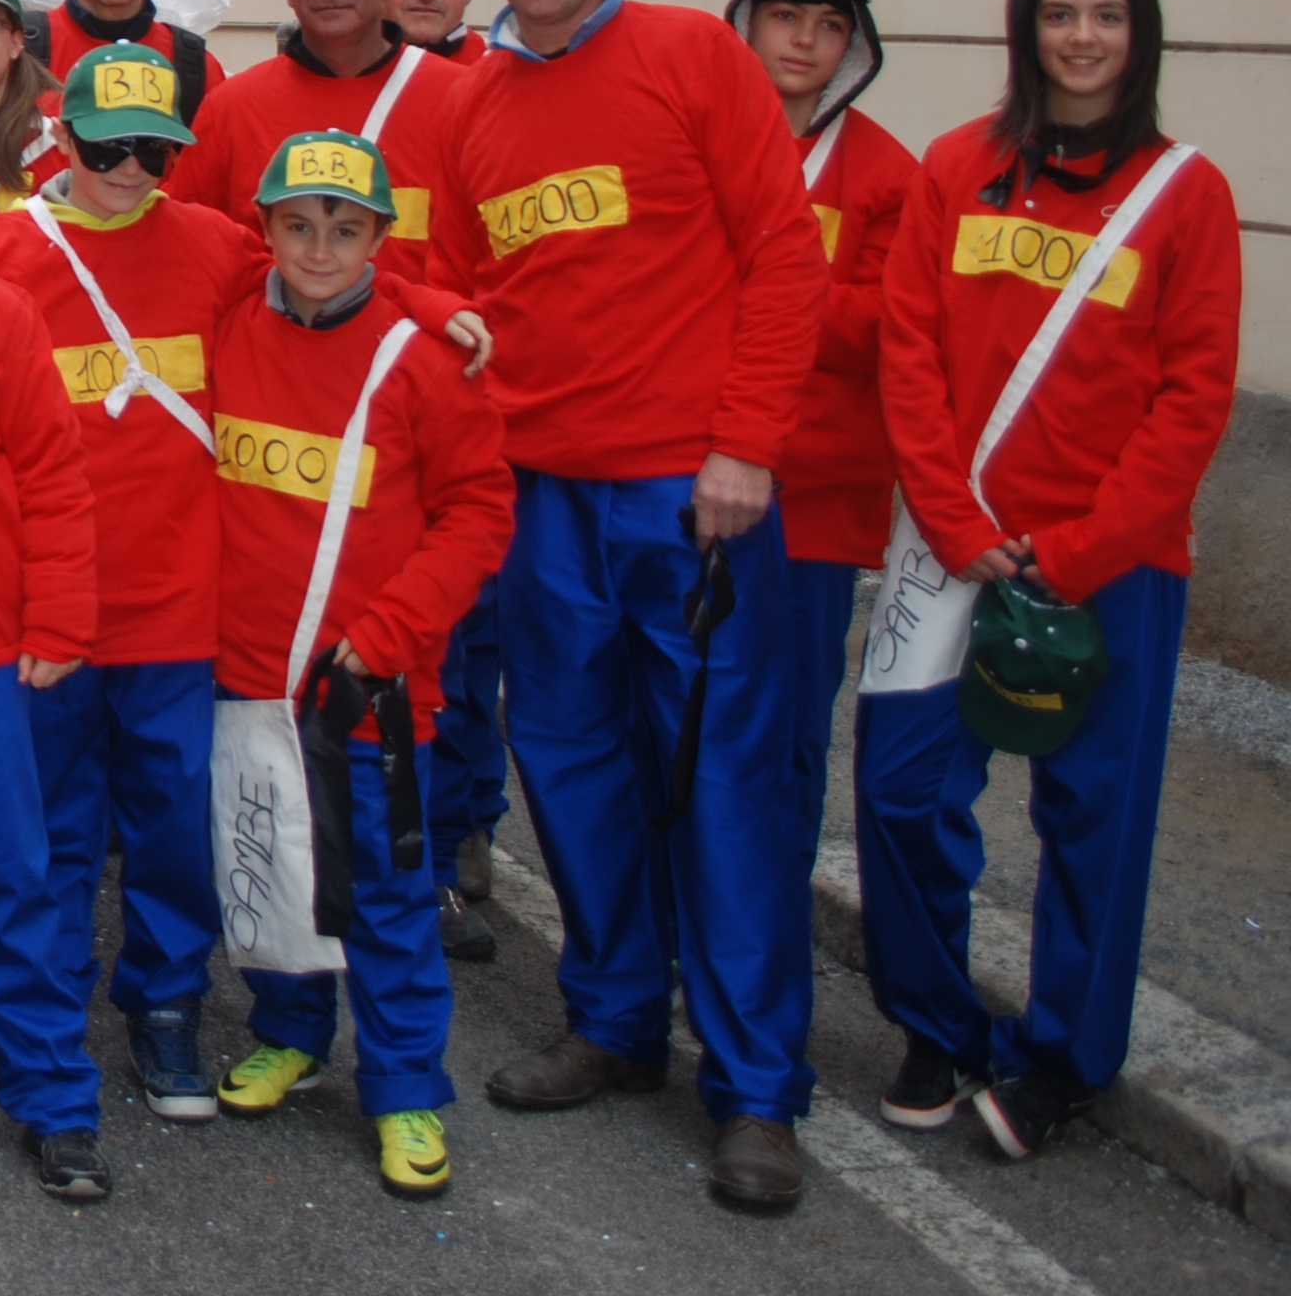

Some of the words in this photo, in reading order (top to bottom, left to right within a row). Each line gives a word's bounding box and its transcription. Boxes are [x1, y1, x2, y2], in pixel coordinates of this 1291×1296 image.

[299, 147, 355, 185] B.B.
[497, 177, 600, 248] 1000
[225, 771, 277, 953] SAMBE
